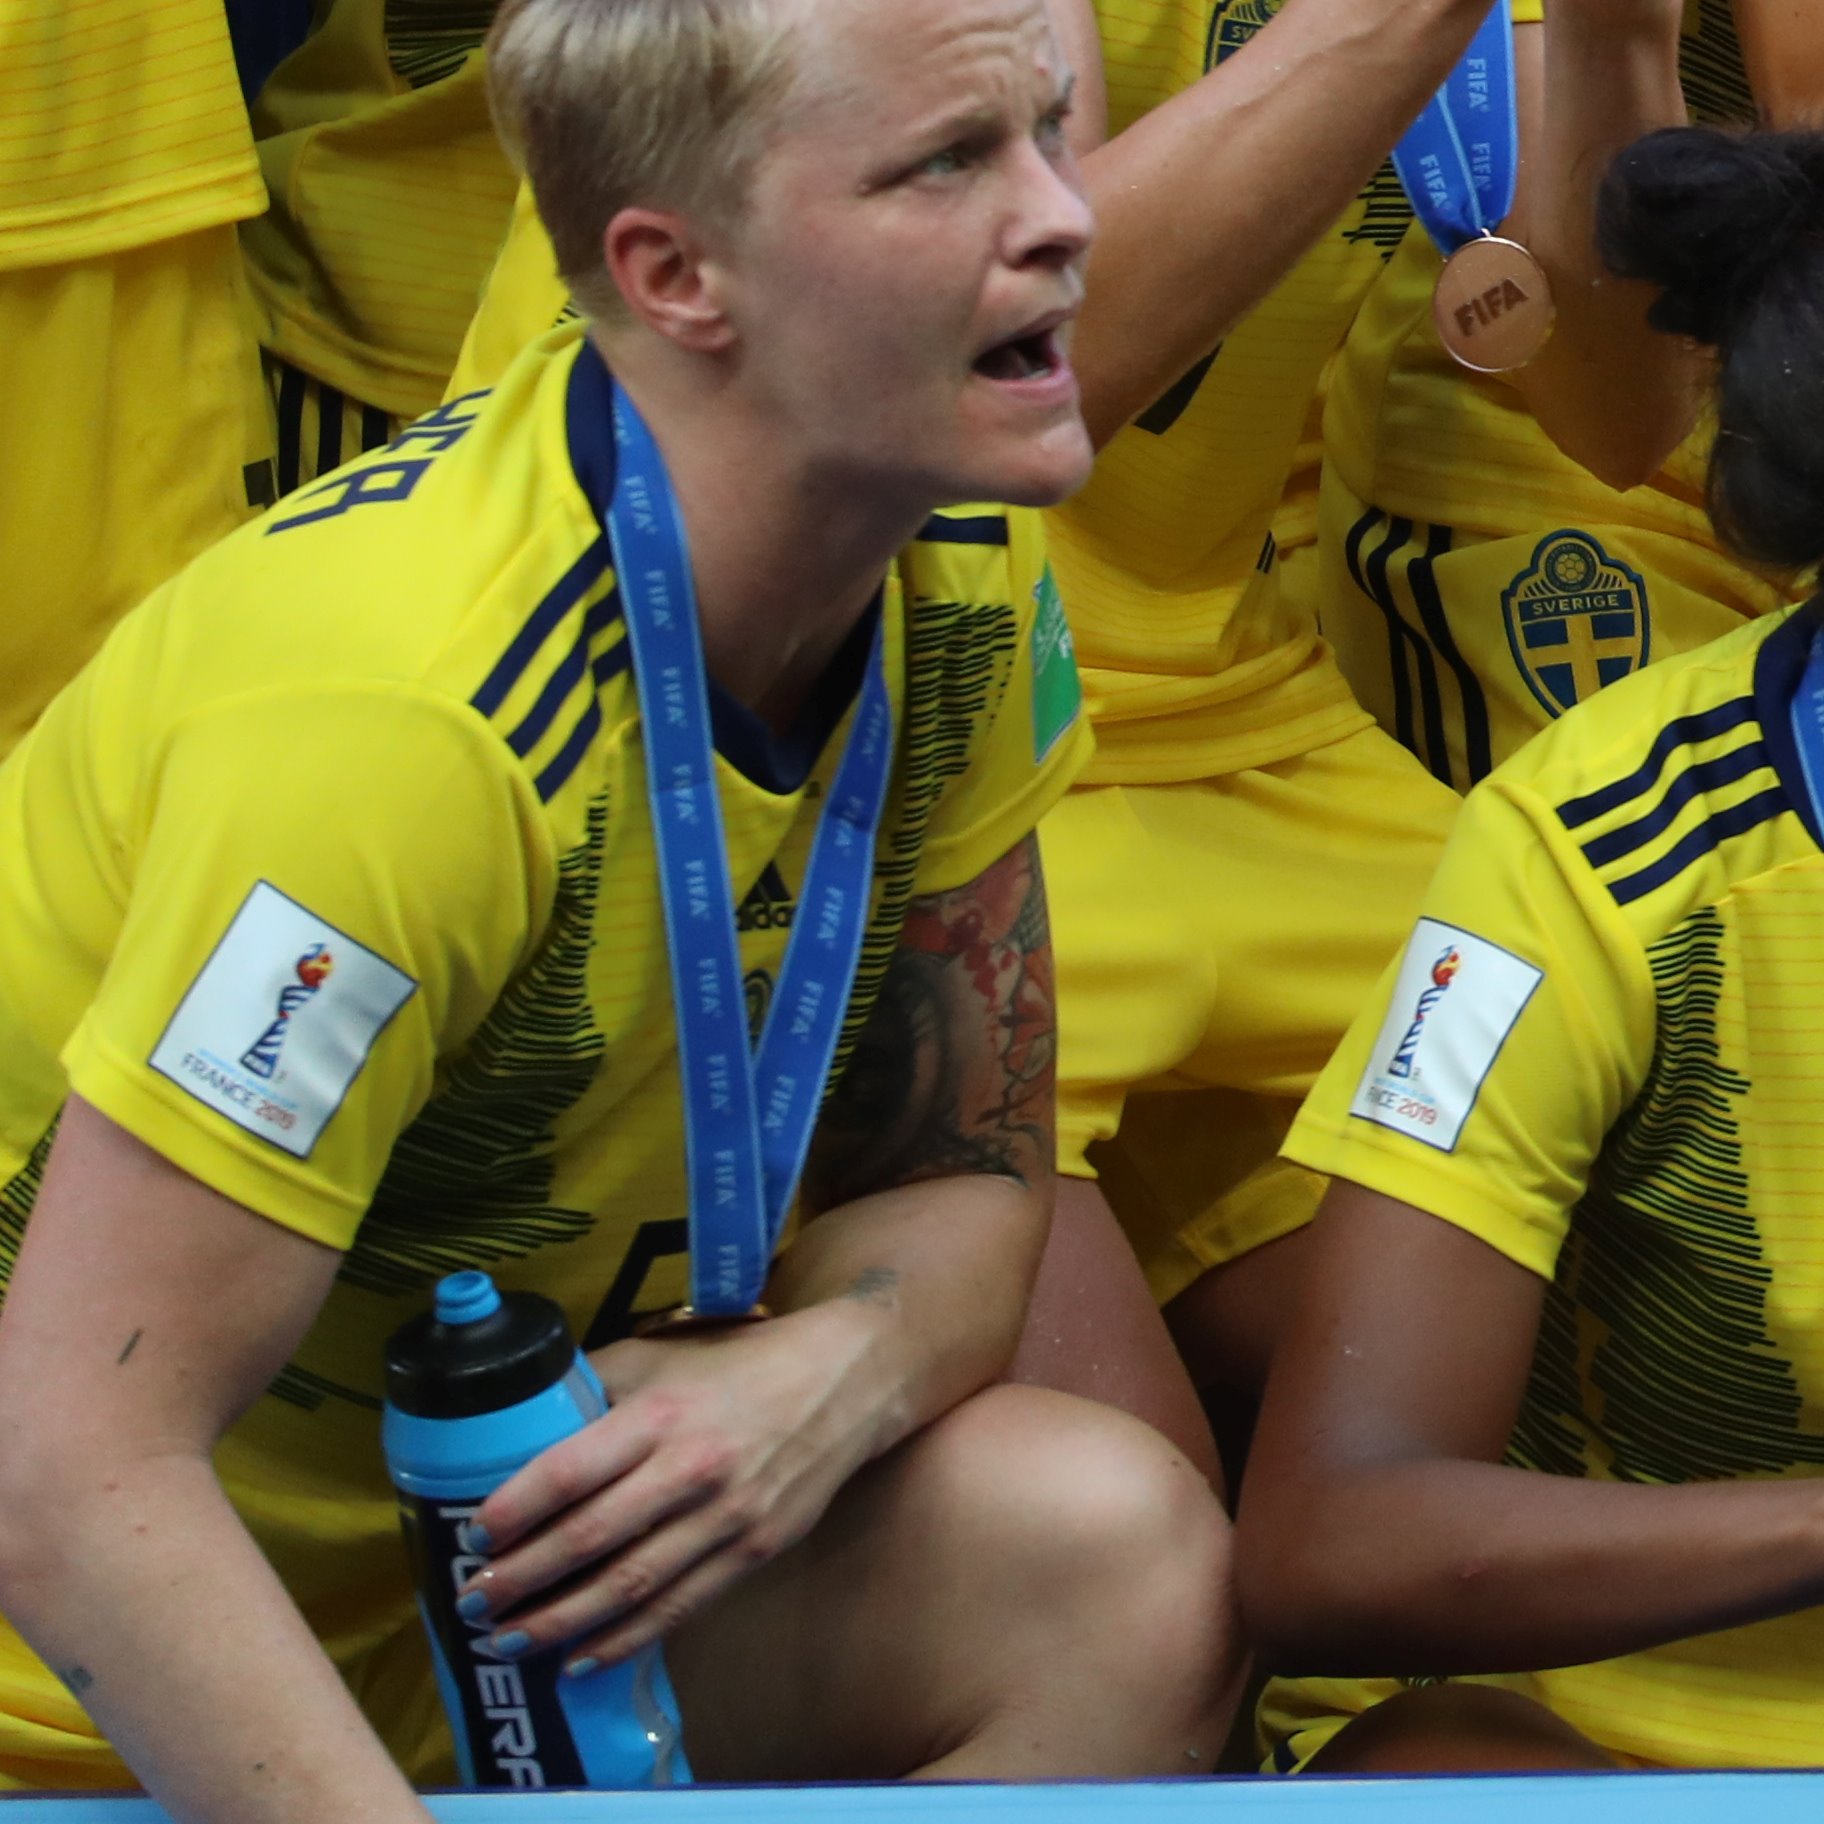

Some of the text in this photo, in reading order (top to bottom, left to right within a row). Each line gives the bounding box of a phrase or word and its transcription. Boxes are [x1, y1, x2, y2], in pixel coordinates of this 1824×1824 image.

[1468, 57, 1488, 110] FIFA
[1419, 153, 1450, 208] FIFA
[1452, 279, 1528, 336] FIFA
[1532, 593, 1619, 614] SVERIGE
[180, 1053, 254, 1109] FRANCE
